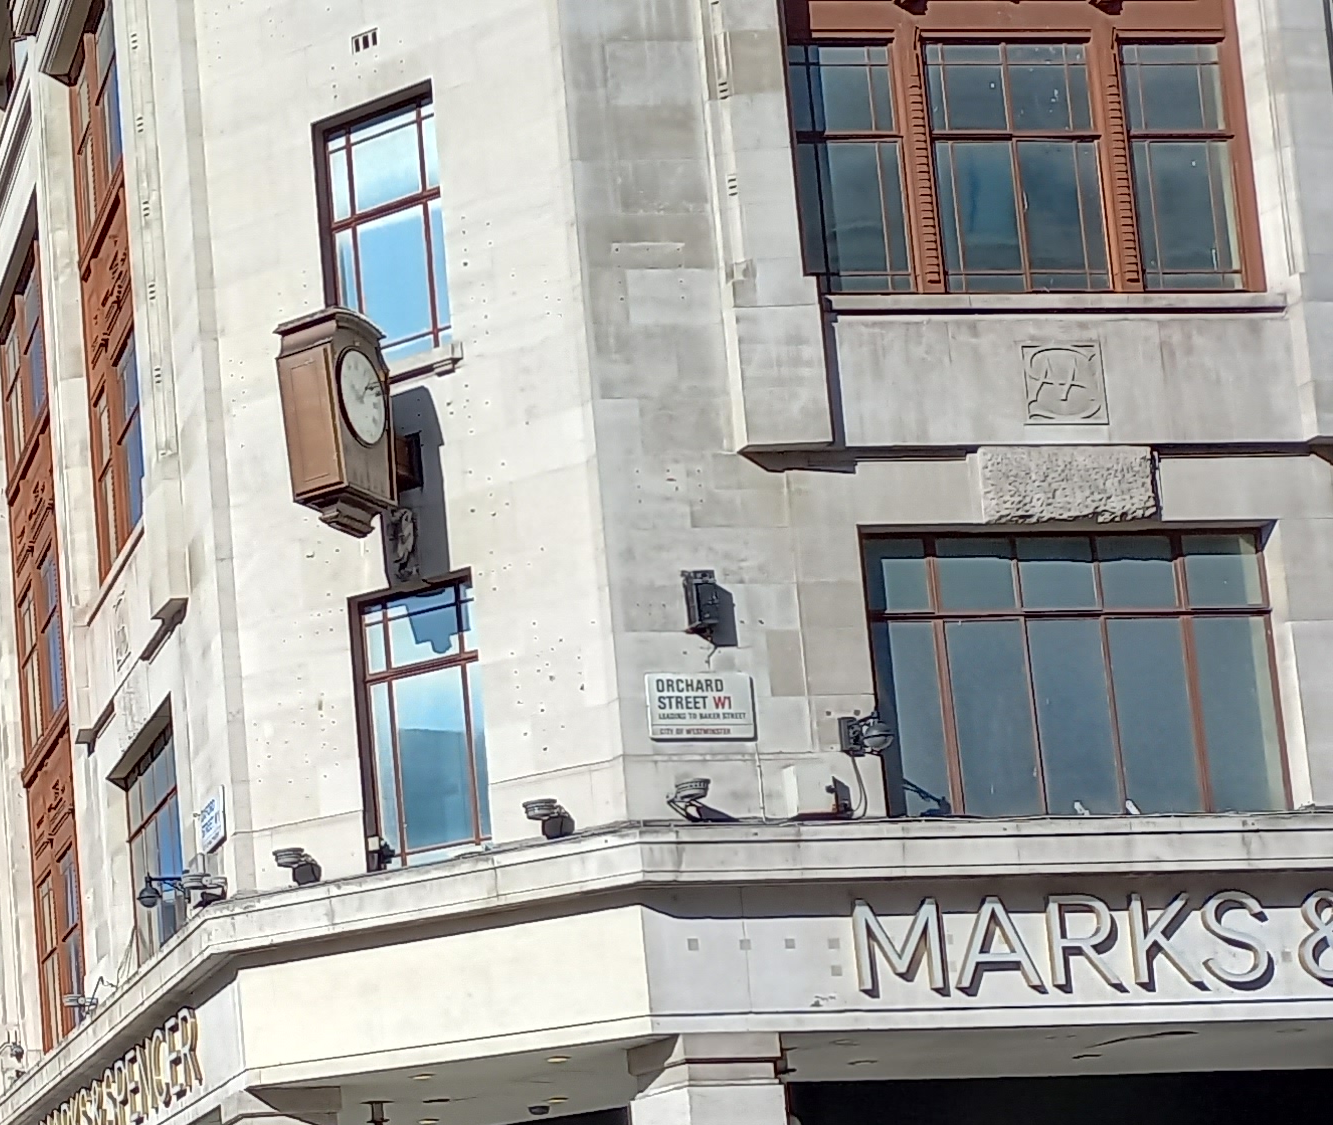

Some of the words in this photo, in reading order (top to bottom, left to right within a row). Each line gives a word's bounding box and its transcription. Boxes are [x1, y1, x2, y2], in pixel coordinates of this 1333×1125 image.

[655, 678, 724, 693] ORCHARD
[657, 695, 708, 710] STREET
[712, 695, 732, 710] W1
[658, 712, 687, 720] LEADING
[688, 712, 698, 720] TO
[699, 712, 721, 720] BAKER
[721, 712, 747, 720] STREET
[852, 889, 1275, 999] MARKS
